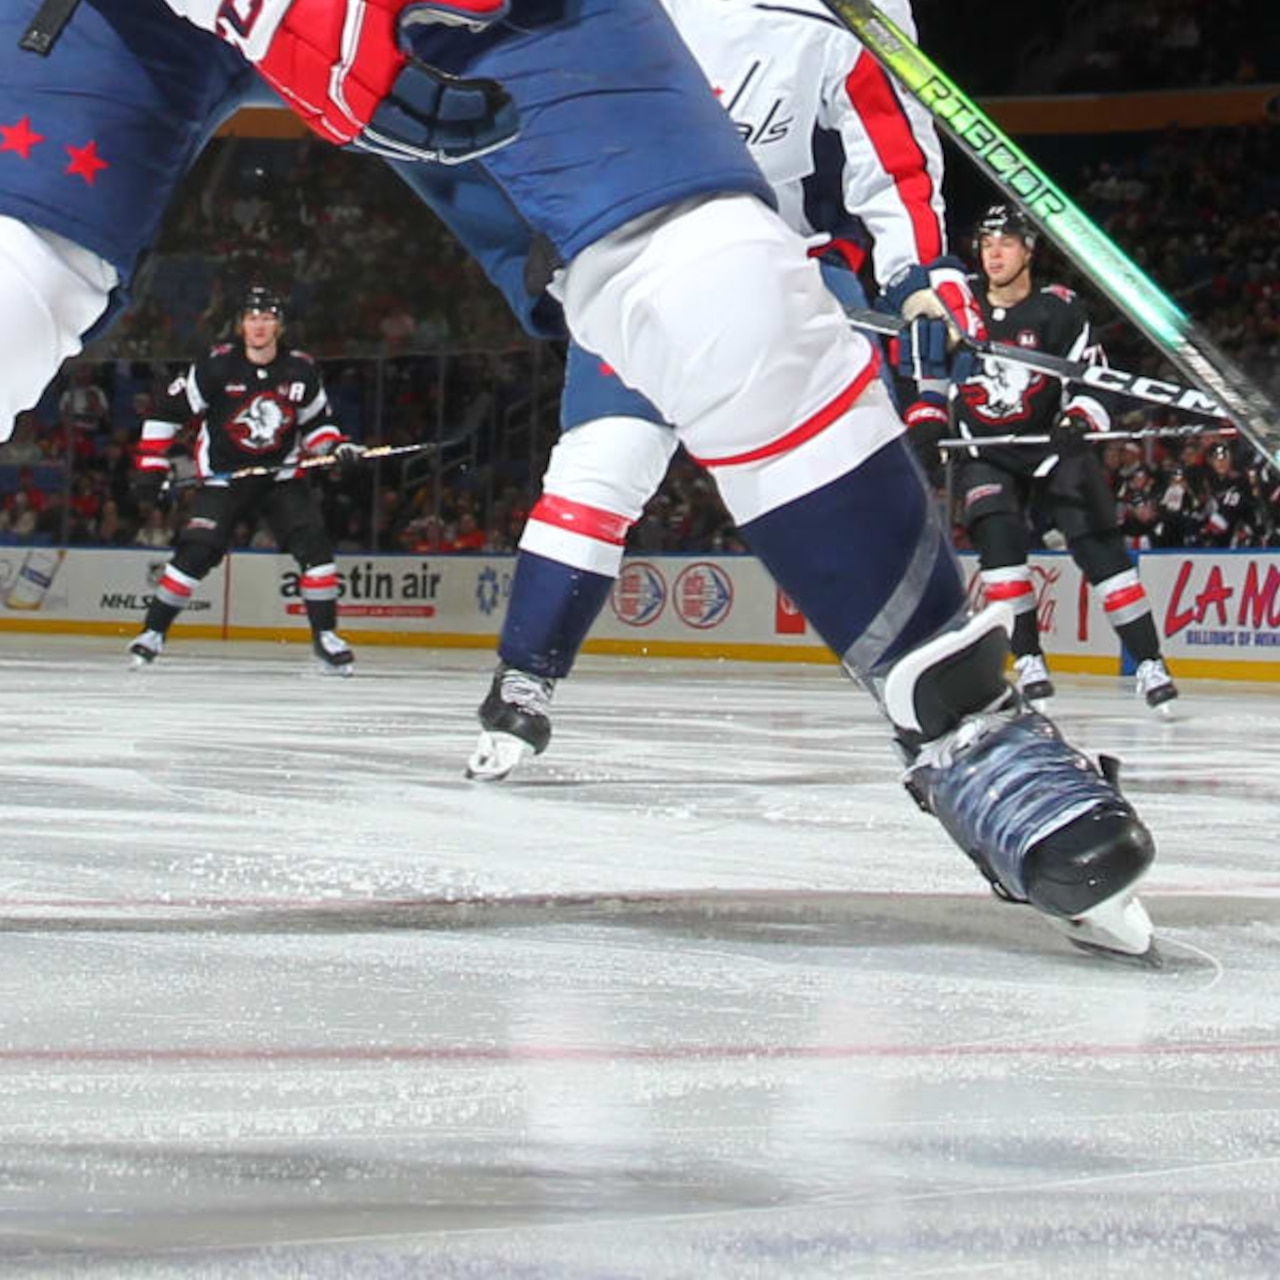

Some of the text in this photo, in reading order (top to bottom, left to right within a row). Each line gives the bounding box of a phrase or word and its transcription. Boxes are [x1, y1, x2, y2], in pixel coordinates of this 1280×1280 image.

[289, 381, 306, 402] A
[280, 563, 441, 599] astin air
[1163, 559, 1234, 638] LA
[1186, 631, 1235, 646] BILLIONS
[1238, 631, 1251, 646] OF
